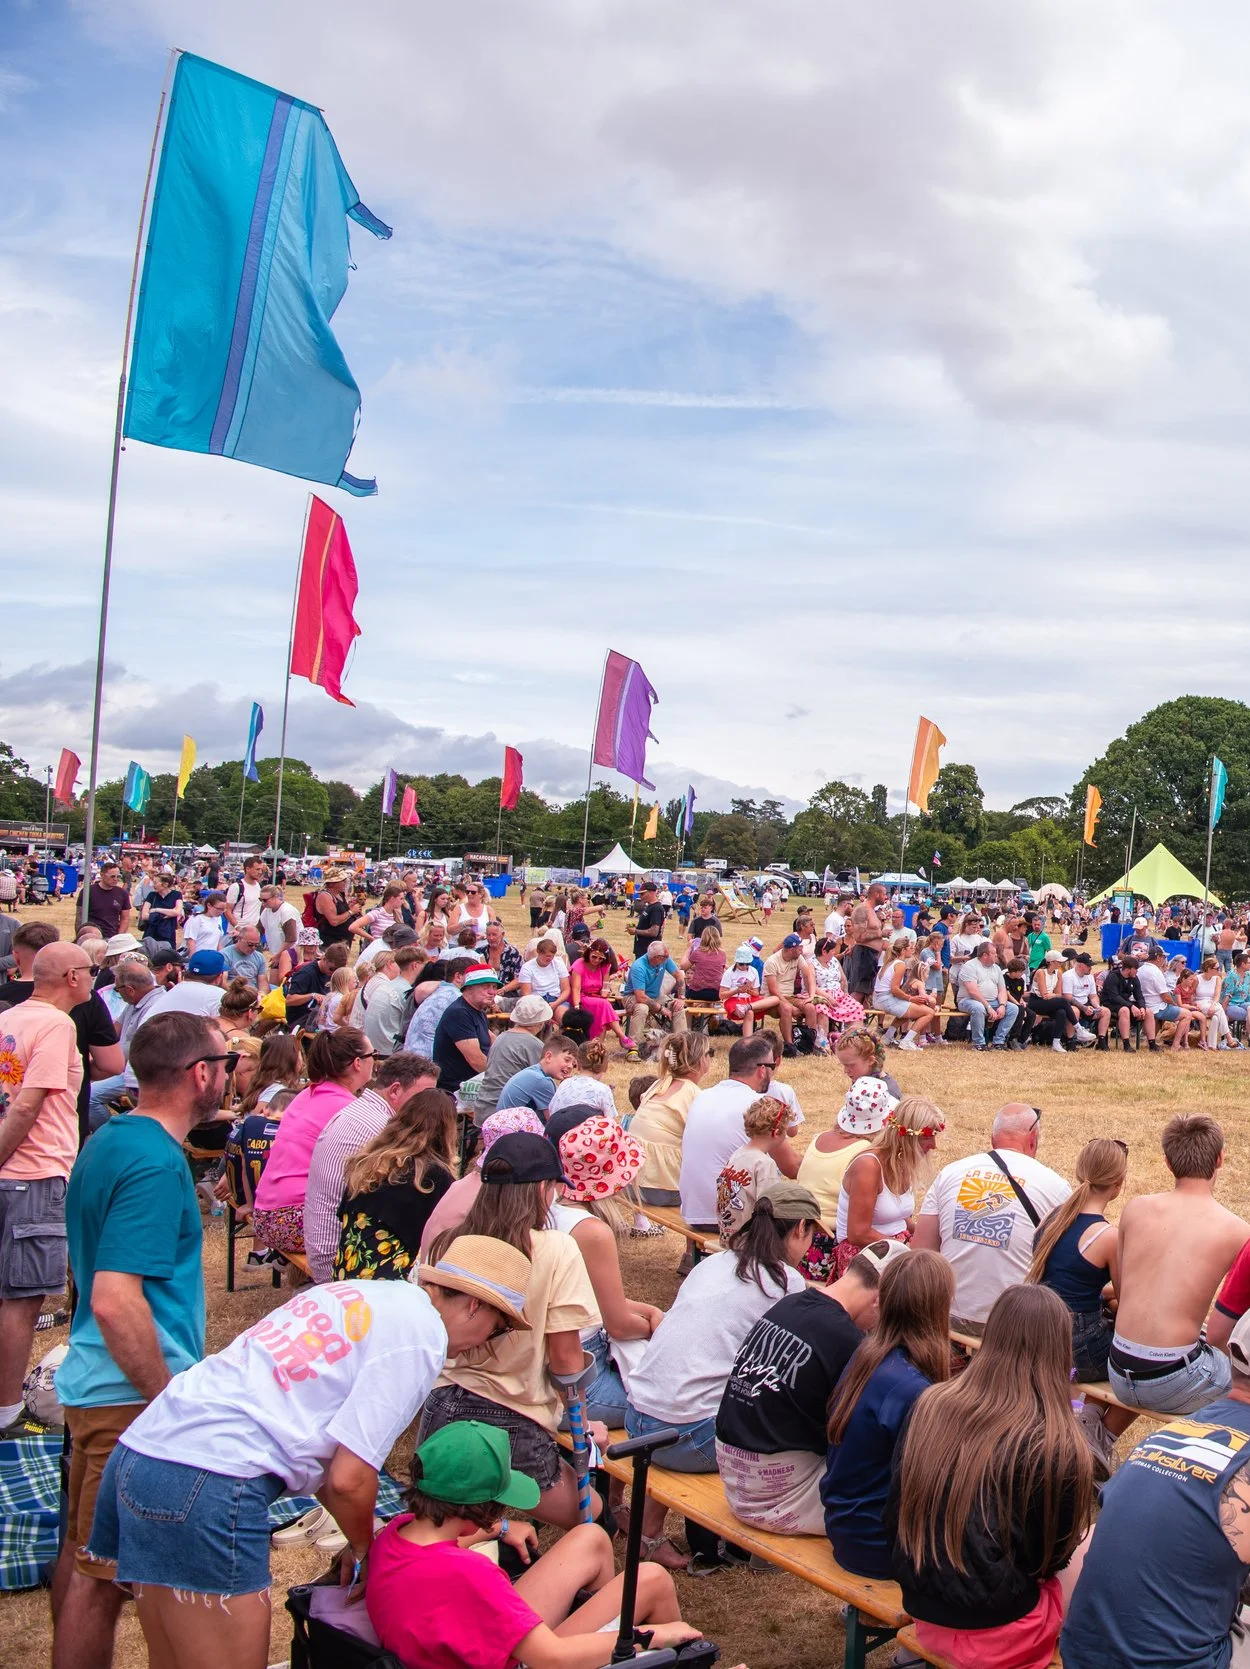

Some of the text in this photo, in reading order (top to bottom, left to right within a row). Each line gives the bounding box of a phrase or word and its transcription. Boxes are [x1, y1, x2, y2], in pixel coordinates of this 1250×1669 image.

[407, 848, 433, 858] GREEK
[469, 854, 497, 862] MACAROONS
[965, 1170, 981, 1178] LA
[763, 1464, 795, 1476] MADNESS
[1151, 1465, 1188, 1482] COLLECTION
